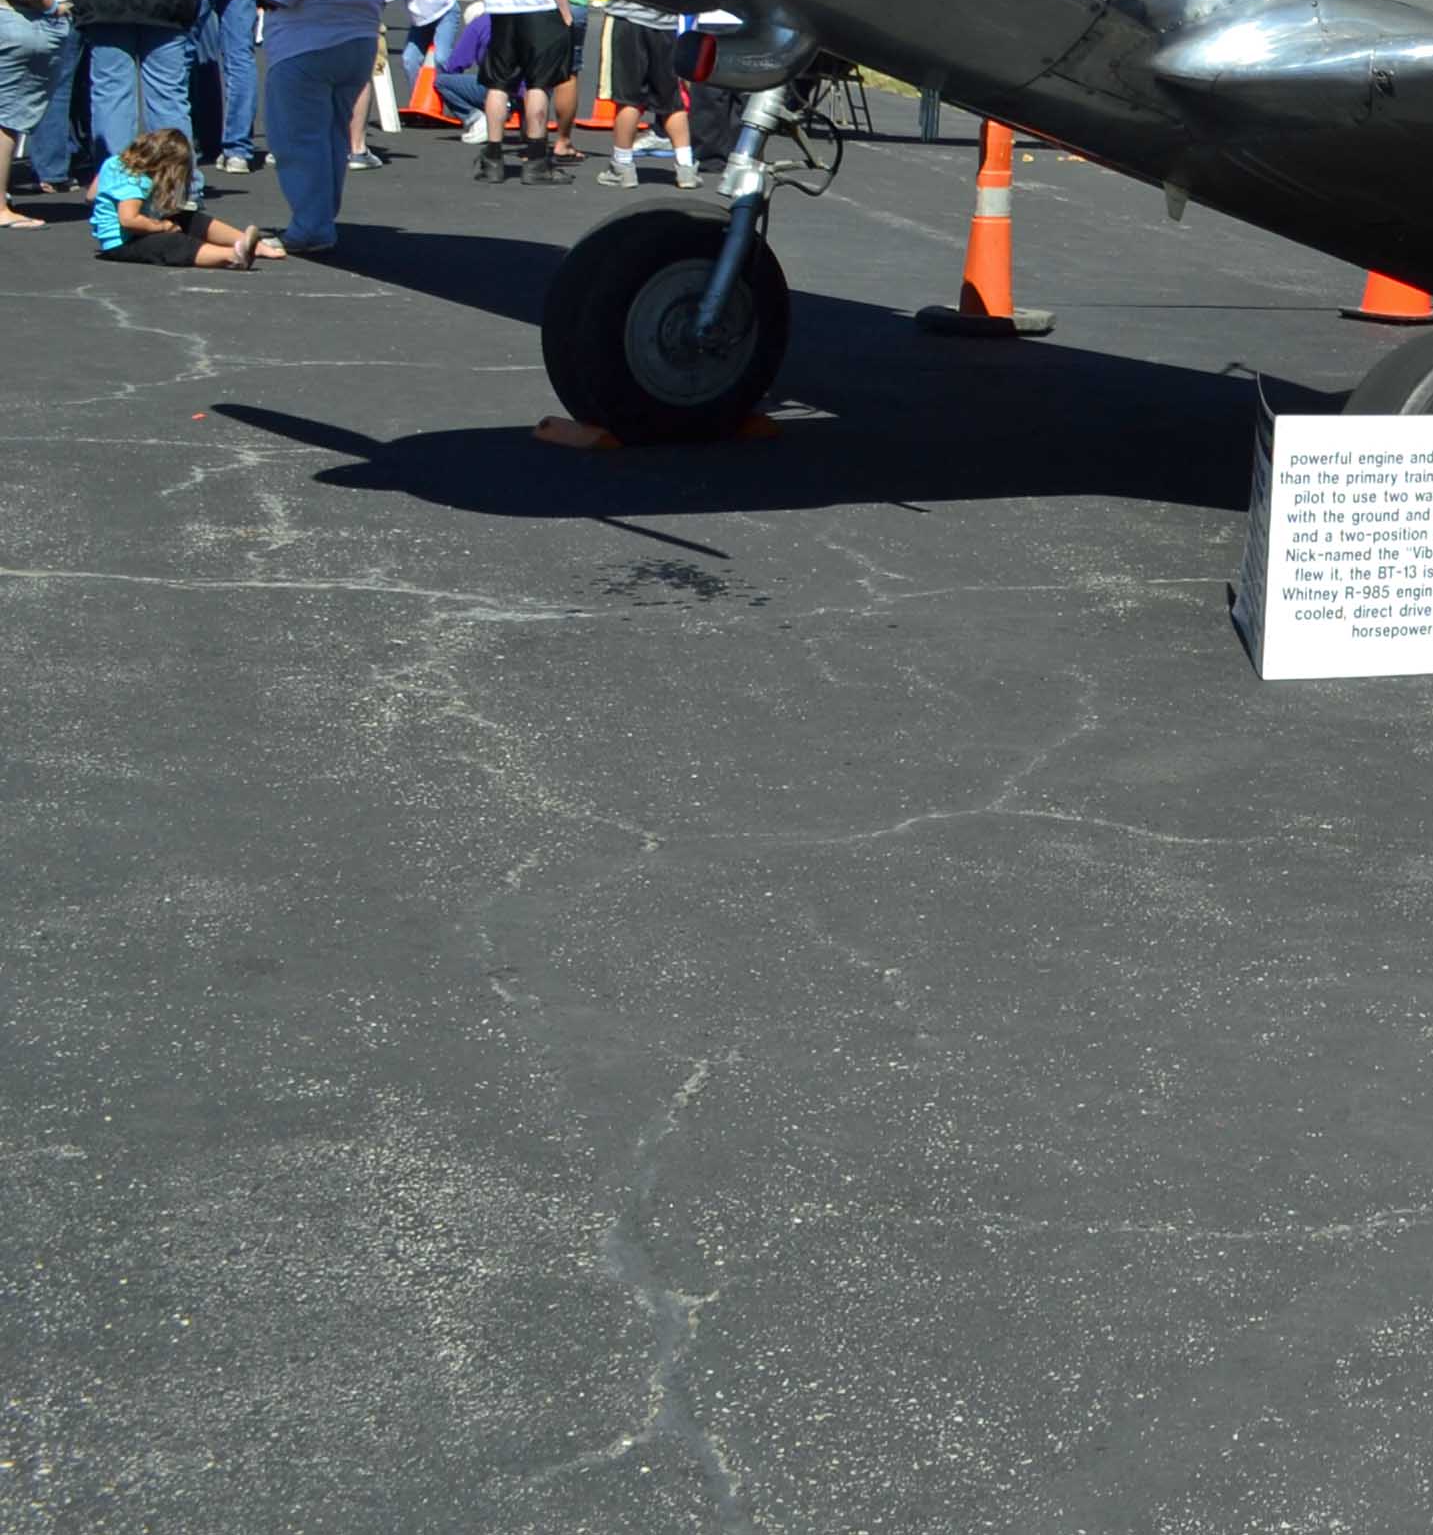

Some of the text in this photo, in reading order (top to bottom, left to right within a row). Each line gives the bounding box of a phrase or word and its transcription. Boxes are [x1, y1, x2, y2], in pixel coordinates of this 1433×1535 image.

[1290, 451, 1352, 467] powerful
[1358, 451, 1403, 467] engine
[1280, 471, 1310, 485] than
[1318, 471, 1339, 484] the
[1346, 471, 1398, 486] primary
[1294, 491, 1324, 505] pilot
[1332, 491, 1346, 503] to
[1353, 493, 1376, 503] use
[1384, 491, 1408, 503] two
[1287, 510, 1316, 523] with
[1323, 510, 1344, 522] the
[1352, 509, 1399, 525] ground
[1406, 508, 1430, 521] and
[1293, 530, 1318, 543] and
[1325, 532, 1332, 542] a
[1340, 527, 1427, 543] two-position
[1285, 548, 1371, 562] Nick-named
[1378, 548, 1399, 560] the
[1295, 568, 1323, 581] flew
[1350, 567, 1371, 580] the
[1378, 565, 1417, 579] BT-13
[1423, 565, 1433, 578] is
[1282, 587, 1338, 603] Whitney
[1345, 585, 1390, 599] R-985
[1295, 606, 1346, 620] cooled,
[1354, 605, 1392, 618] direct
[1399, 604, 1431, 616] drive
[1352, 625, 1432, 639] horsepower
